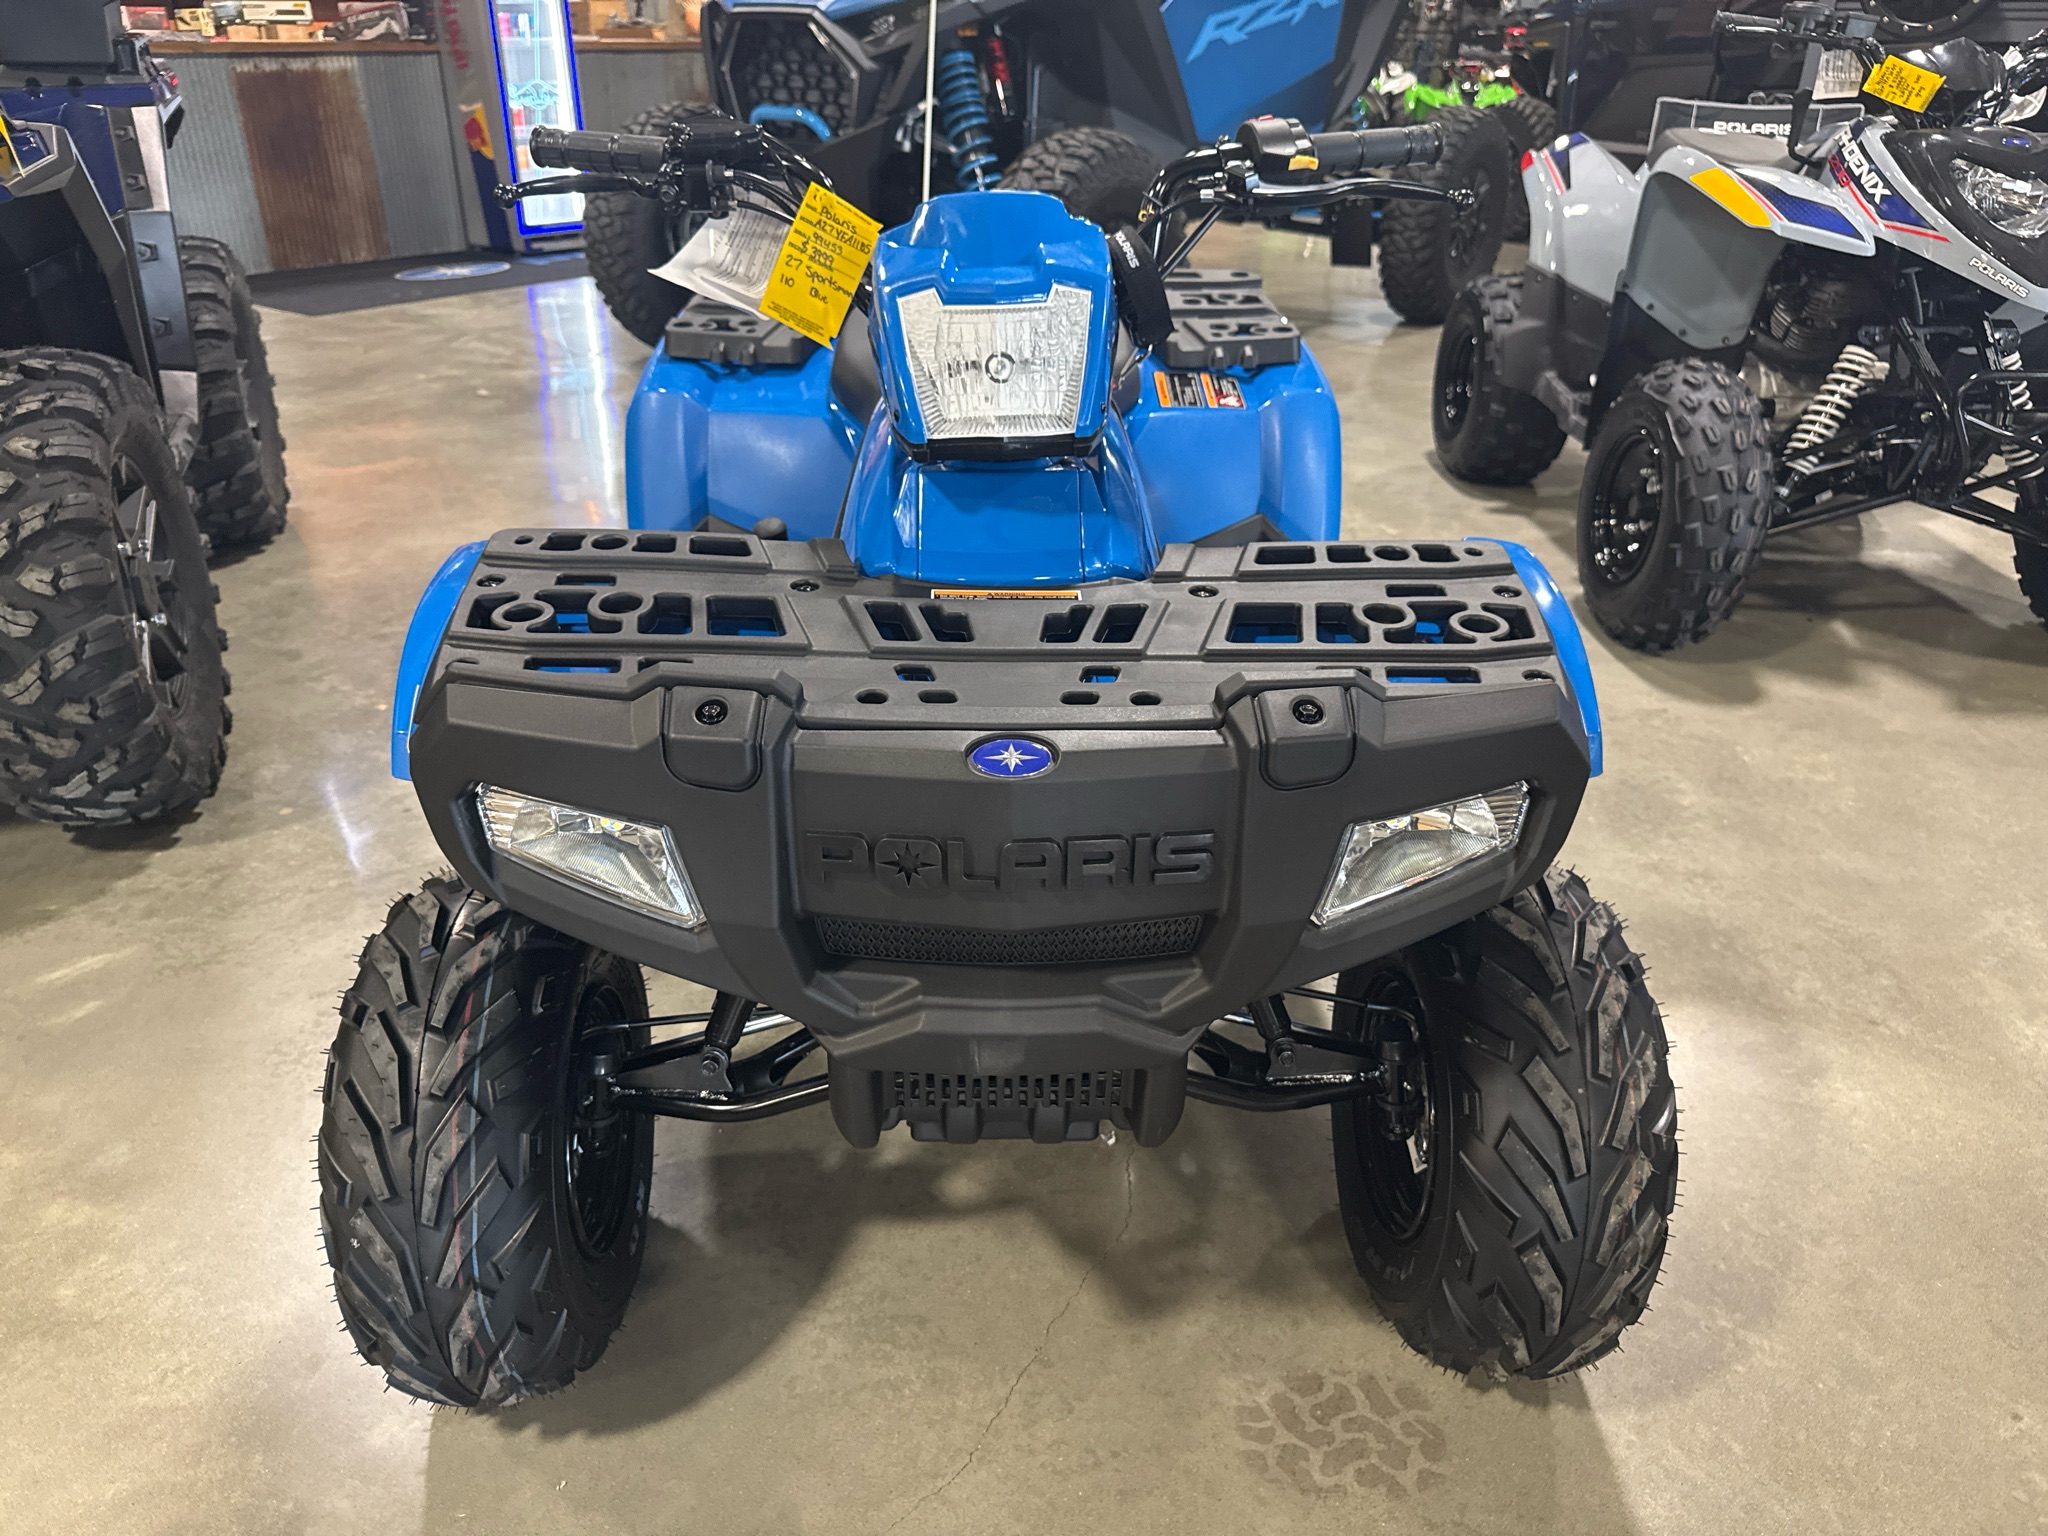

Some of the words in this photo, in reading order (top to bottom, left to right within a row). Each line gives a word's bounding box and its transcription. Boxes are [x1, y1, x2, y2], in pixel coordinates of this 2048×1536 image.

[1713, 120, 1791, 135] POLARIS
[1834, 126, 1893, 205] PHOENIX
[820, 206, 858, 235] Polaris
[779, 273, 795, 288] 110
[809, 286, 829, 305] Blue
[785, 254, 804, 271] 27
[805, 265, 855, 299] Sportsman
[1968, 257, 2030, 298] POLARIS
[806, 829, 1216, 894] POLARIS
